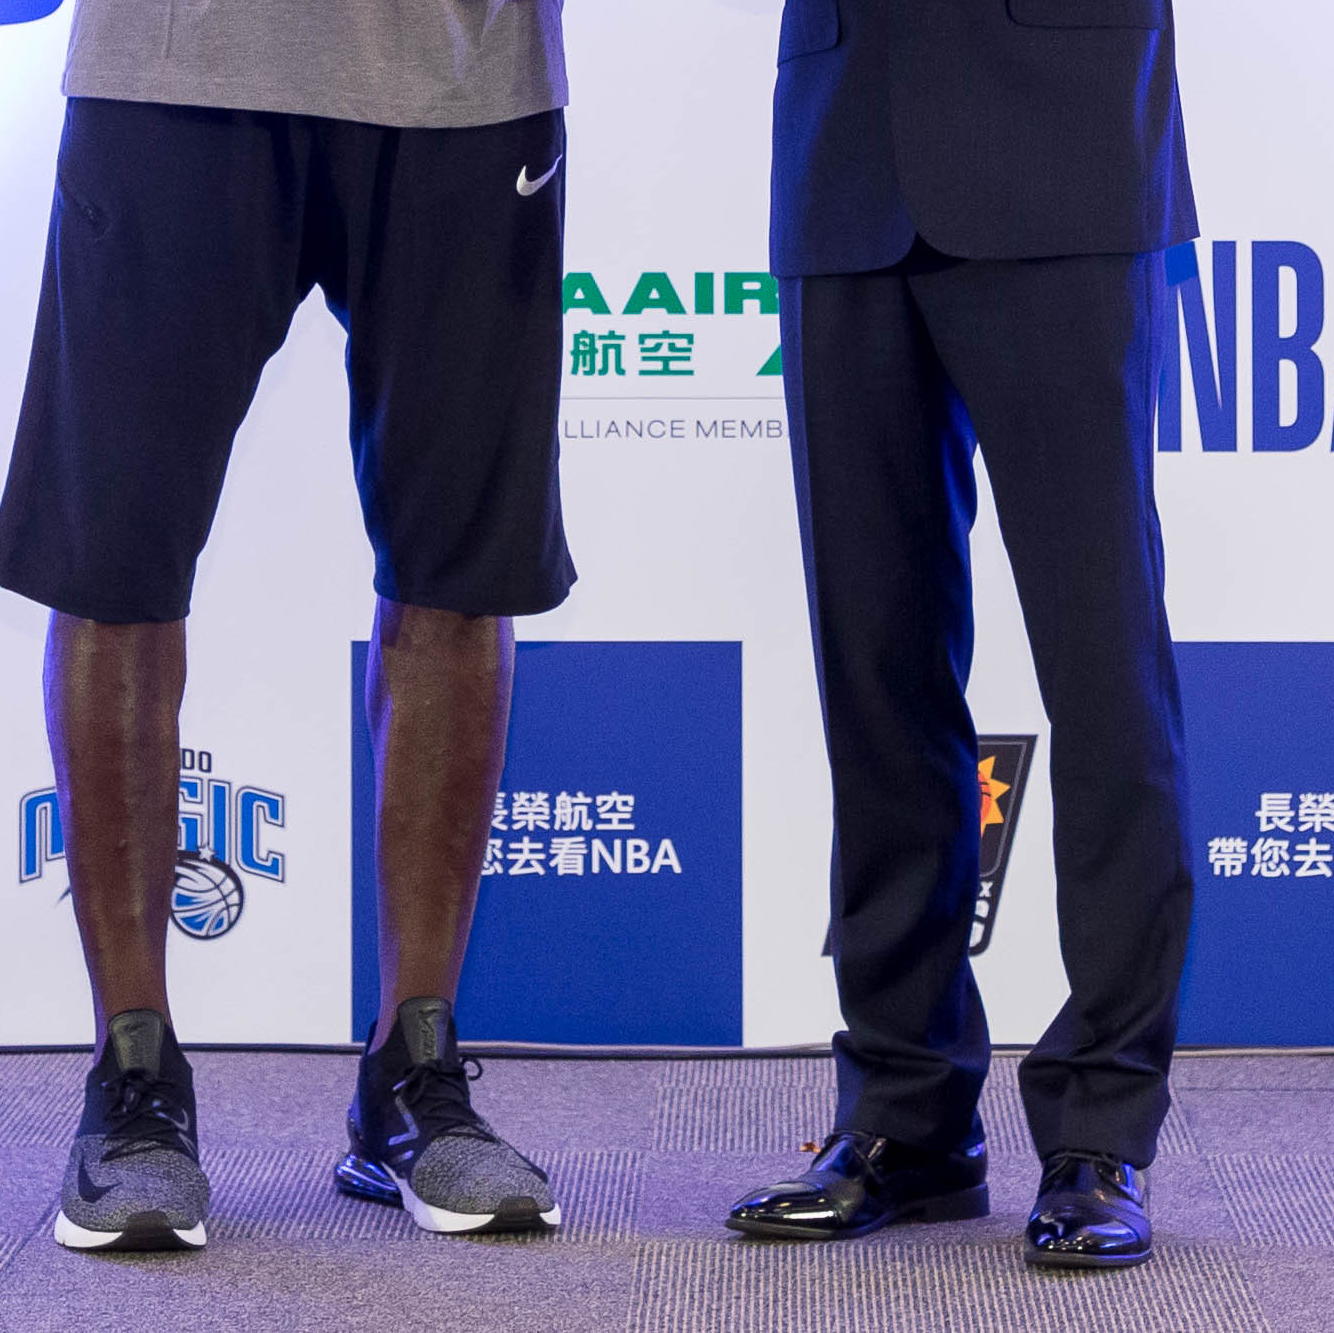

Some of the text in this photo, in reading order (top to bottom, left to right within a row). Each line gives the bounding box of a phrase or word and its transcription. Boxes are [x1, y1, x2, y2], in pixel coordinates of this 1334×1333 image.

[570, 330, 695, 377] 航空
[563, 419, 785, 439] LLIANCE MEMB
[19, 776, 286, 885] MGIC
[481, 836, 683, 876] 去看NBA
